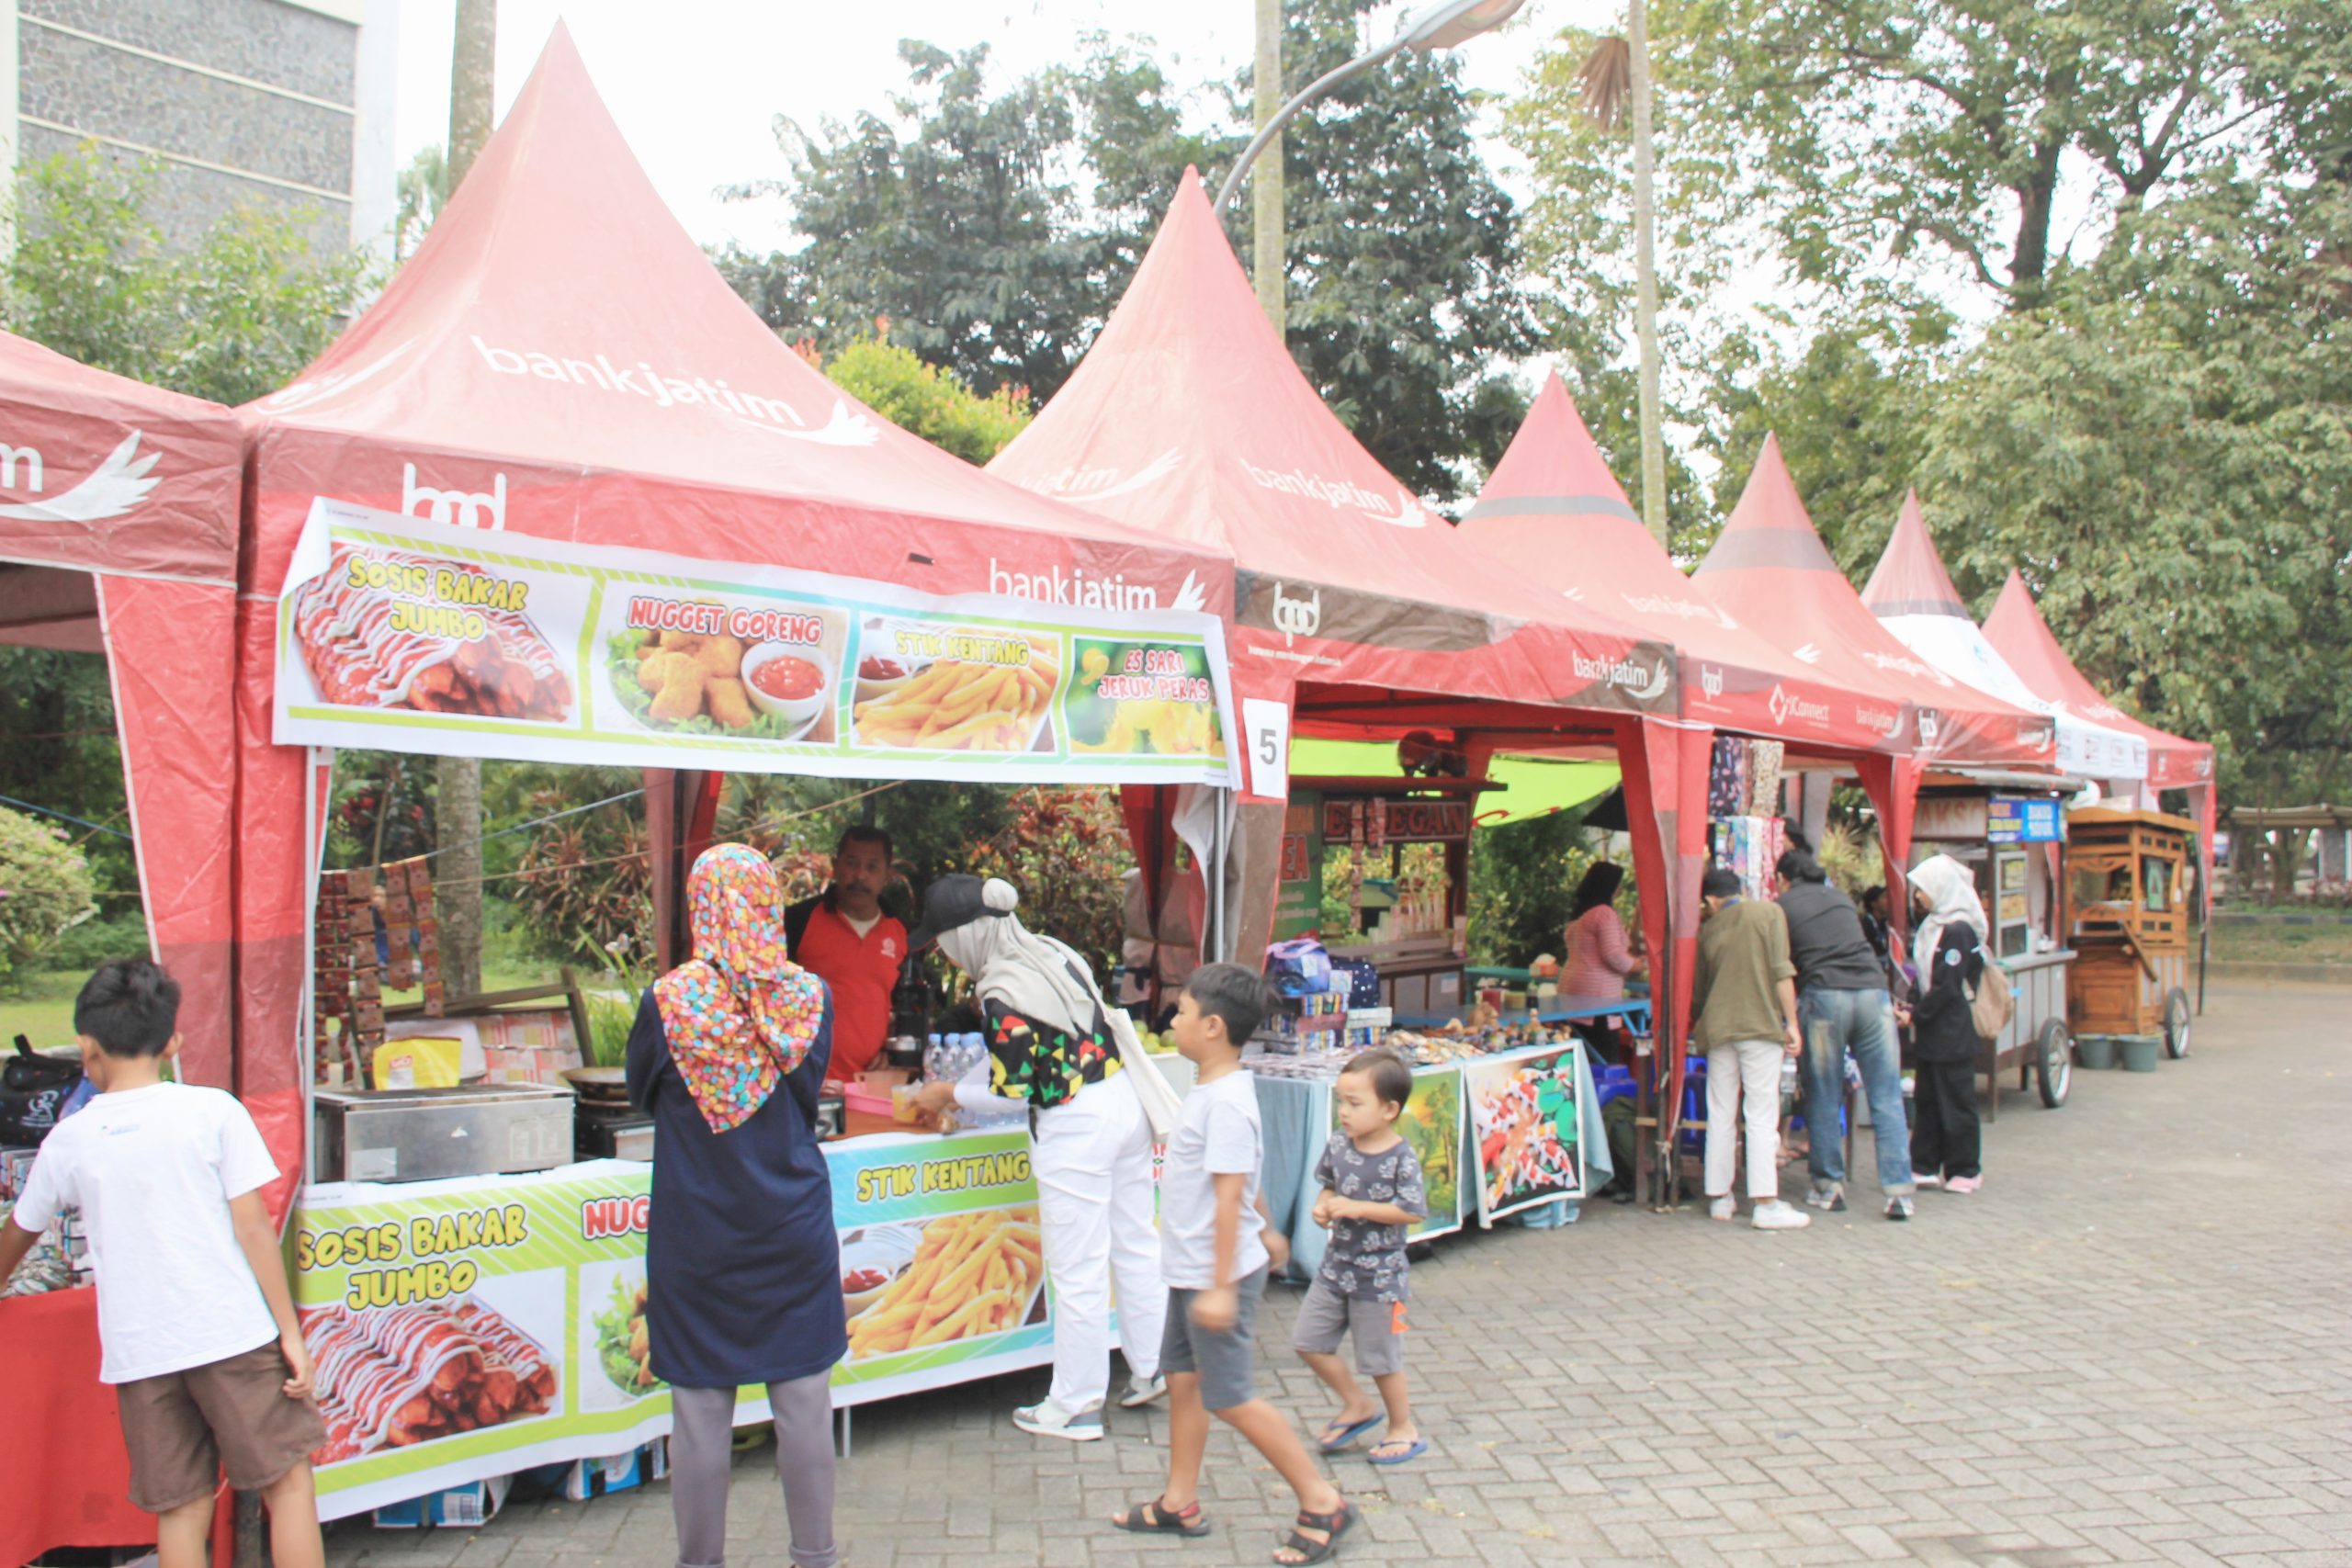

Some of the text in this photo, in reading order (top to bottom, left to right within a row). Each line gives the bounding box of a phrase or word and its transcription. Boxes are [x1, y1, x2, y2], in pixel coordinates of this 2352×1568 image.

[470, 334, 805, 427] bankjatim
[346, 555, 528, 613] SOSIS BAKAR
[389, 601, 485, 639] JUMBO
[628, 597, 823, 645] NUGGET GORENG
[895, 631, 1028, 665] STIK KENTANG
[1124, 649, 1183, 673] ES SARI
[1098, 675, 1210, 701] JERUK PERAS
[1260, 728, 1276, 764] 5
[1388, 803, 1464, 834] EGAN
[1281, 834, 1310, 882] EA
[856, 1151, 1031, 1202] STIK KENTANG
[298, 1223, 401, 1271] SOSIS
[410, 1204, 527, 1257] BAKAR
[346, 1260, 477, 1311] JUMBO
